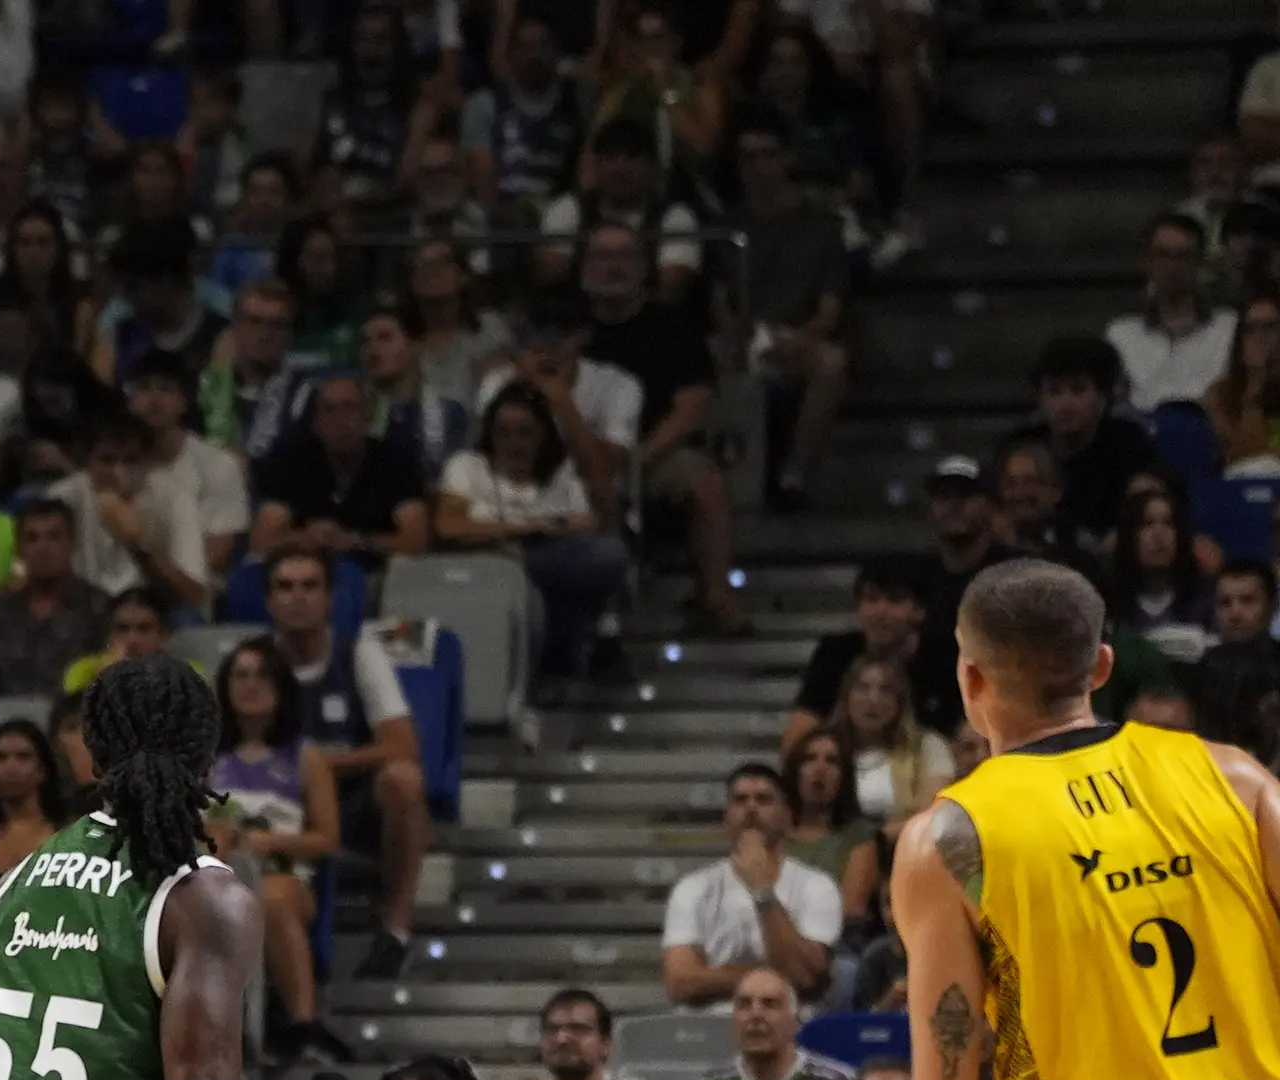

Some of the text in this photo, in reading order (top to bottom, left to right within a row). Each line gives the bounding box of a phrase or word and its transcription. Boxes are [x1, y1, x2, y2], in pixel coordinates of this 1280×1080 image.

[1067, 766, 1134, 819] GUY
[25, 851, 133, 898] PERRY
[1130, 916, 1219, 1057] 2
